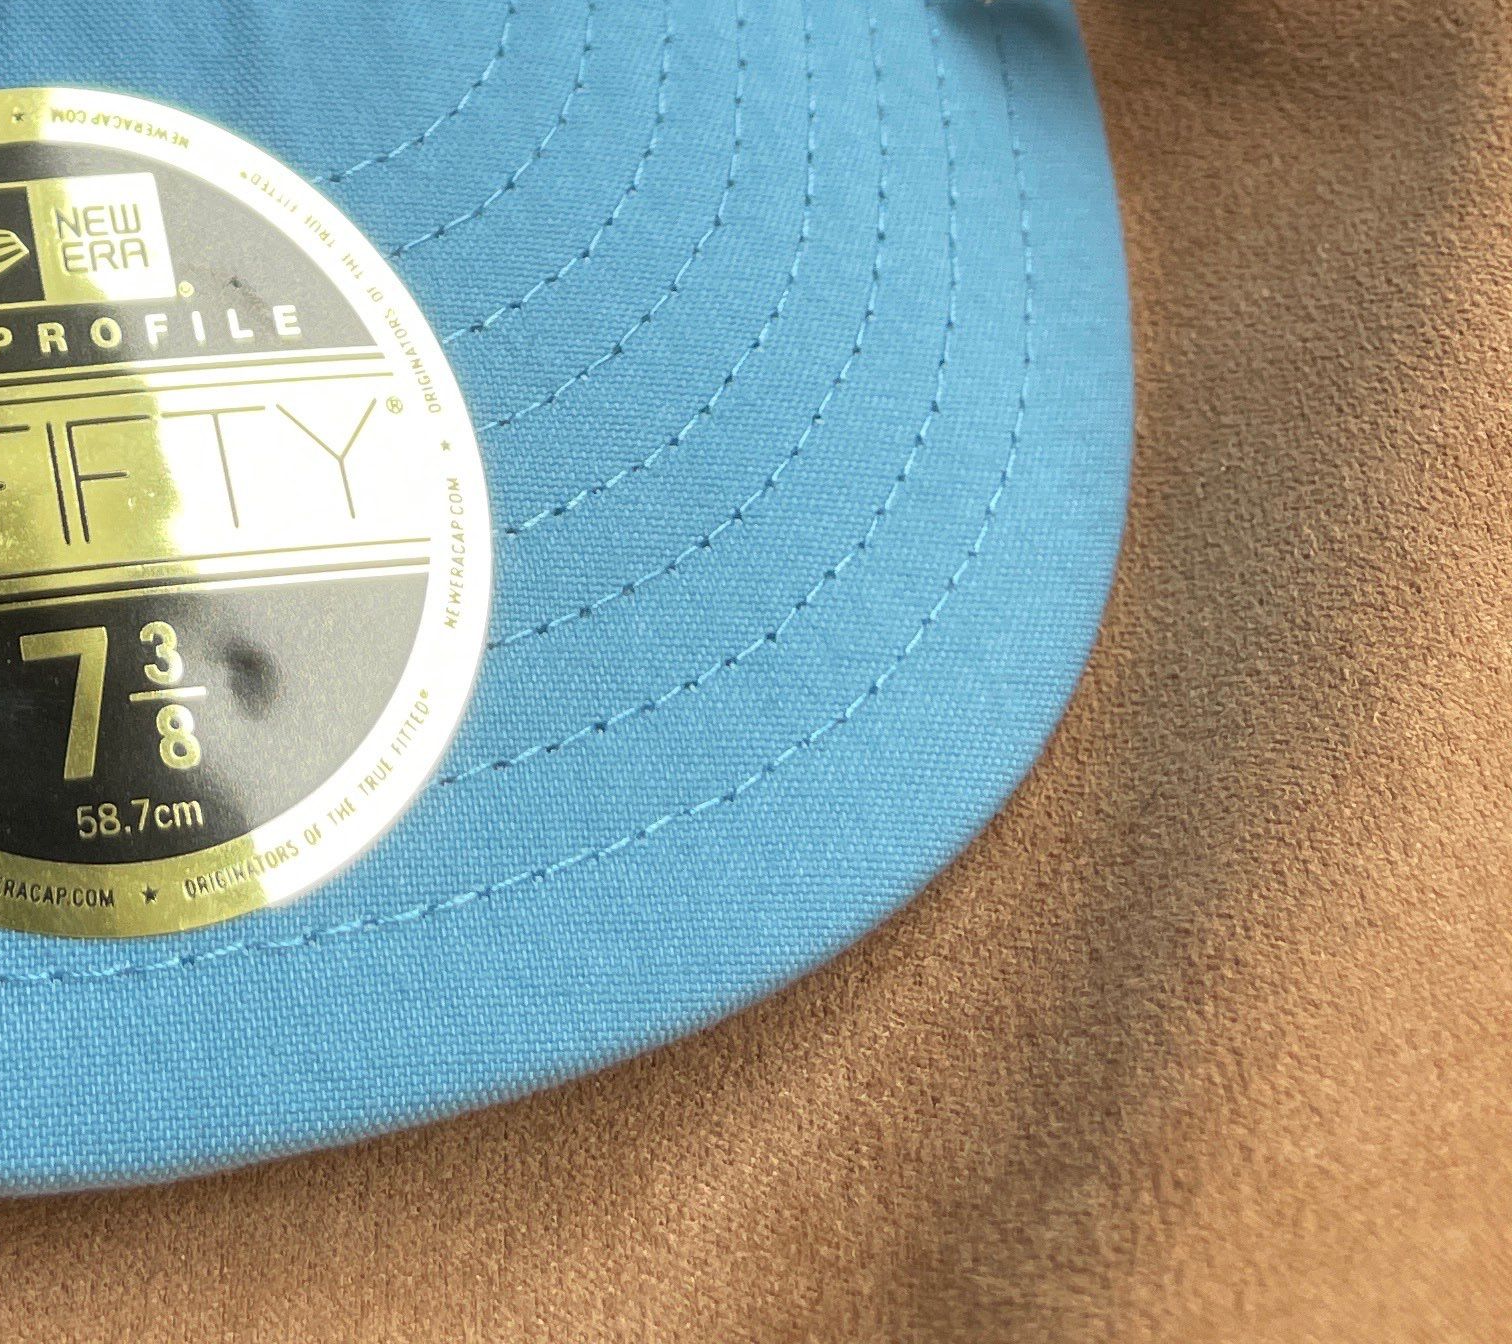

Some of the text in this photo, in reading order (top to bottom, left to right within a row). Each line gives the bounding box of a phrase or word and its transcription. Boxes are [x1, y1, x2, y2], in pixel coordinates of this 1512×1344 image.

[51, 203, 142, 239] NEW
[63, 236, 149, 277] ERA
[19, 625, 108, 781] 7
[76, 797, 205, 841] 58.7cm
[183, 839, 300, 900] ORIGINATORS
[303, 823, 324, 845] OF
[327, 800, 358, 828] THE
[358, 759, 394, 797] TRUE
